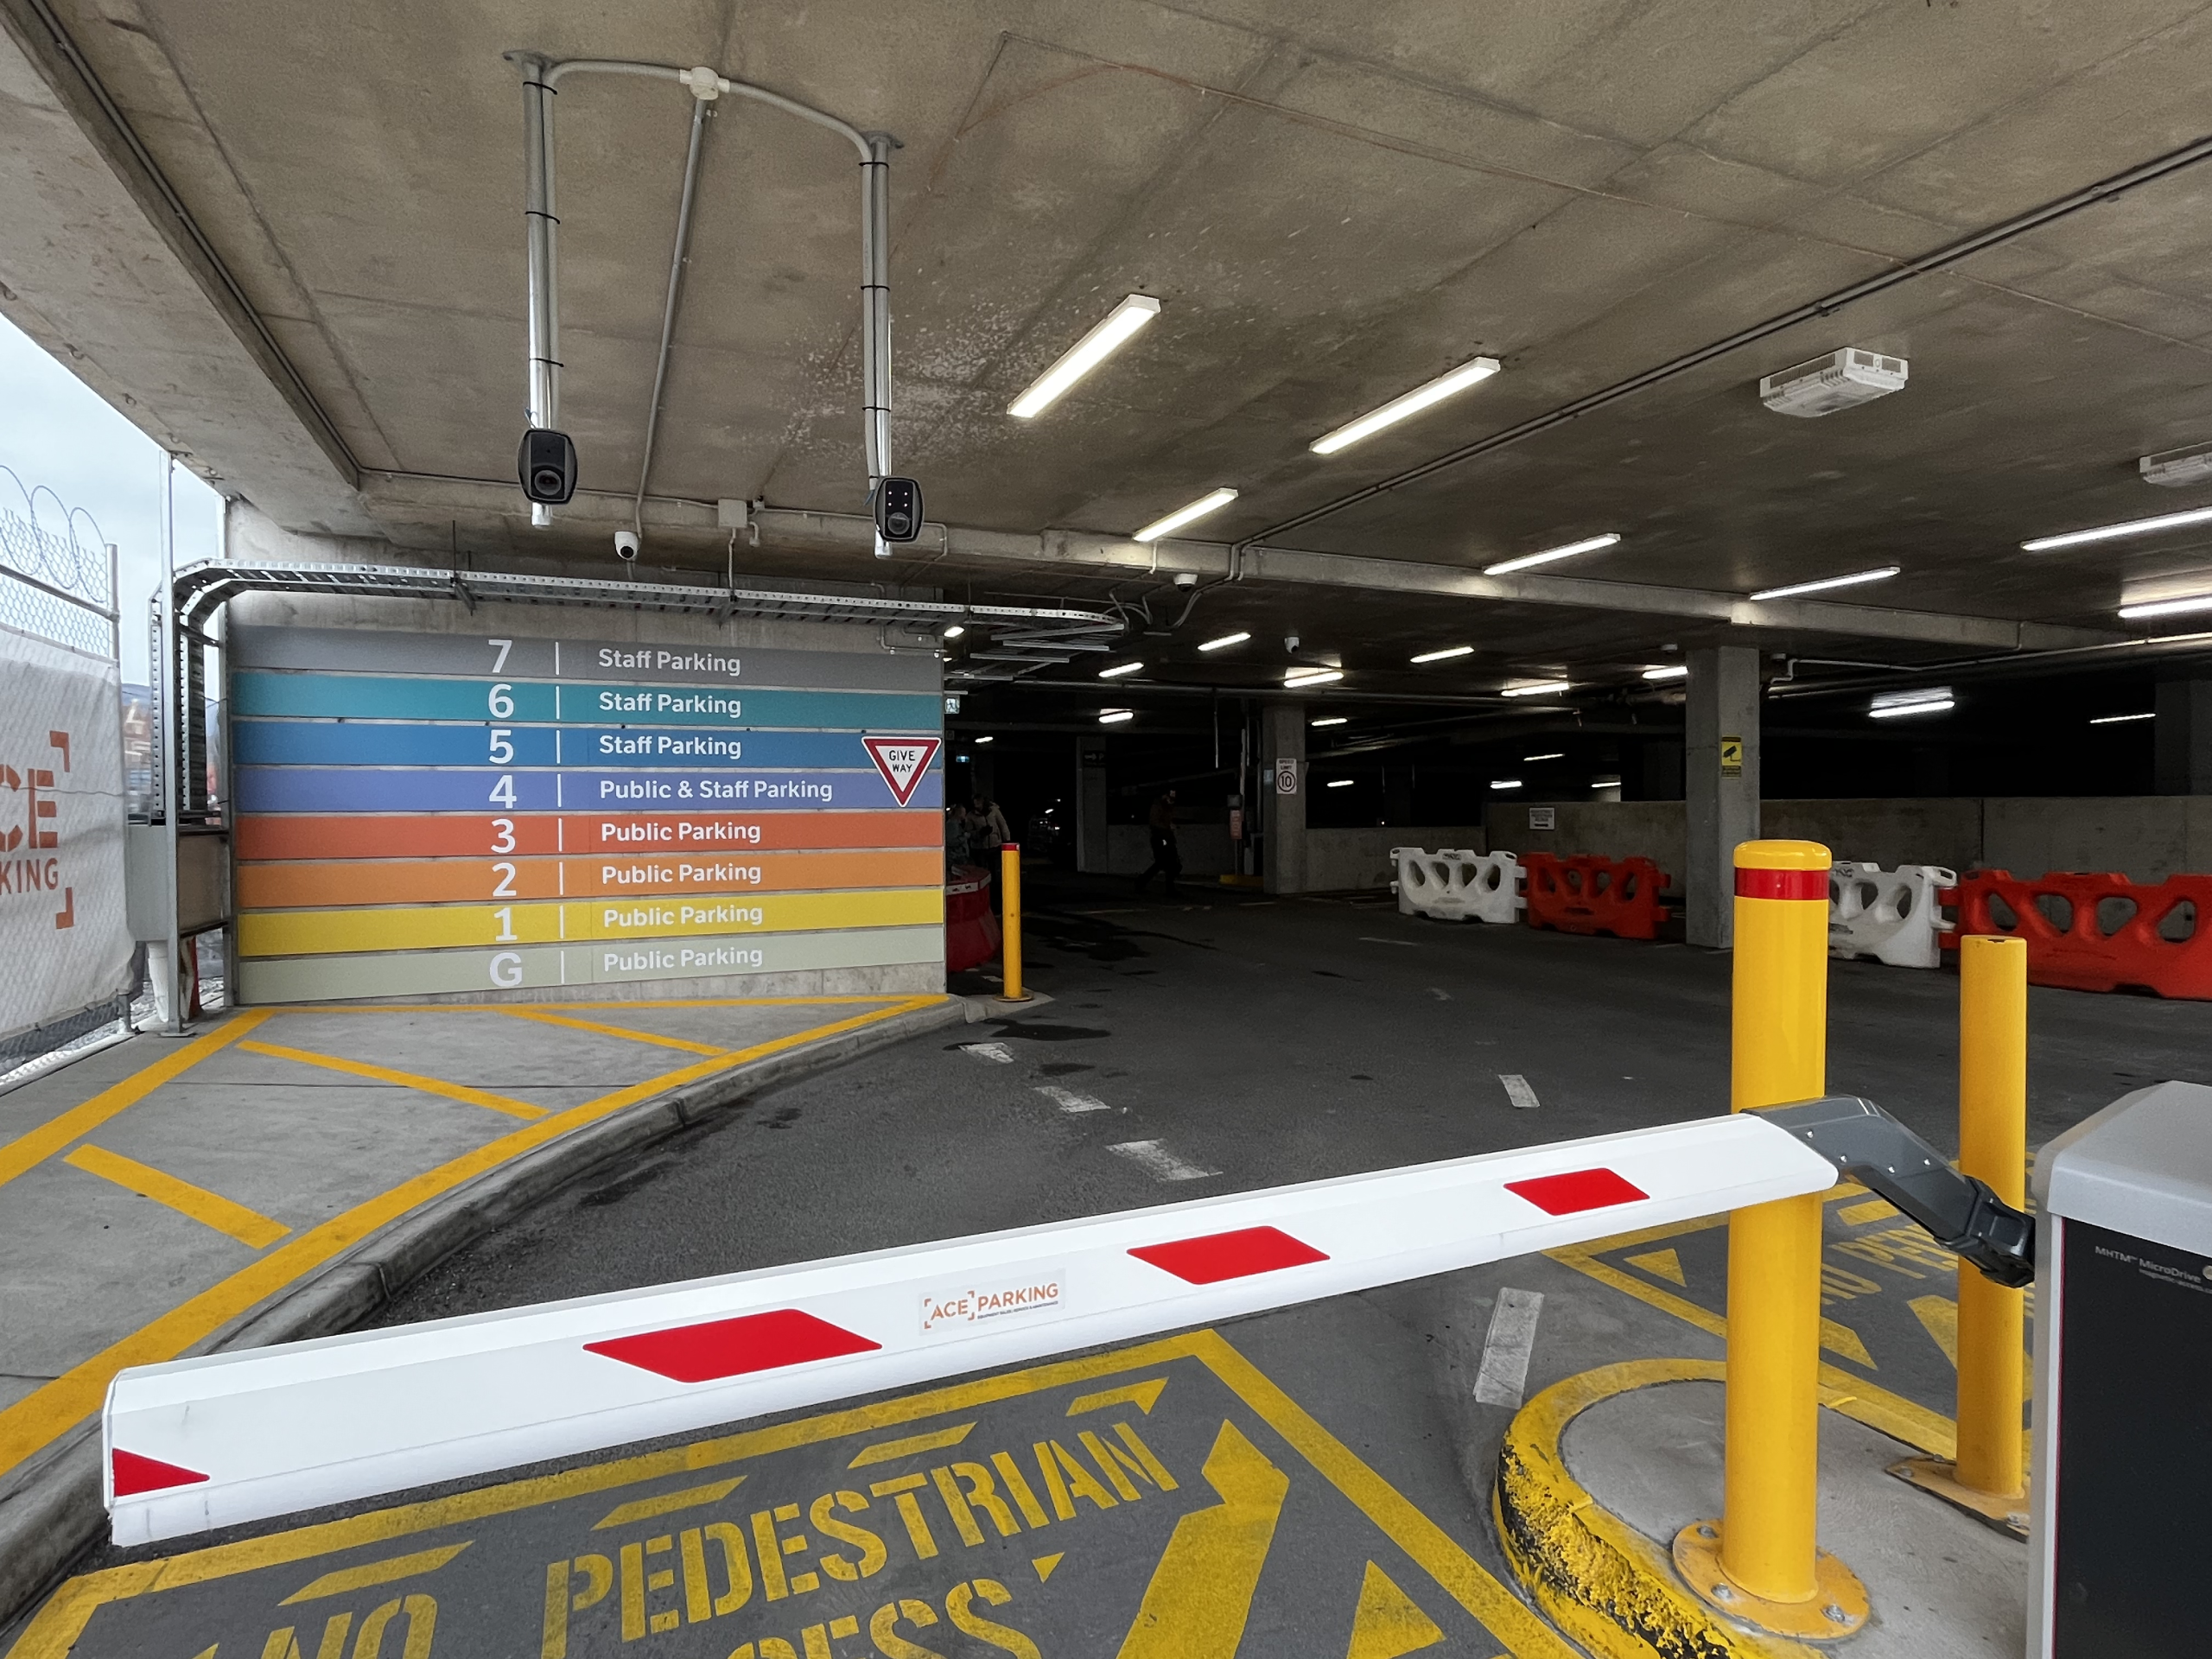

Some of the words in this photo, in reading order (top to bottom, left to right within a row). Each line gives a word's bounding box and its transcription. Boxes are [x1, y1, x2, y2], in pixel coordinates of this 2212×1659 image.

[488, 639, 512, 673] 7
[599, 648, 652, 669] Staff
[657, 651, 741, 677] Parking
[488, 683, 514, 718] 6
[599, 691, 652, 712] Staff
[658, 694, 741, 718] Parking
[489, 729, 514, 764] 5
[599, 735, 652, 754] Staff
[658, 736, 741, 760] Parking
[888, 750, 916, 761] GIVE
[892, 764, 912, 772] WAY
[1281, 775, 1292, 787] 10
[489, 774, 517, 809] 4
[600, 779, 671, 799] Public
[677, 780, 694, 798] &
[699, 780, 749, 798] Staff
[753, 780, 833, 802] Parking
[491, 818, 516, 854] 3
[601, 823, 672, 842] Public
[678, 822, 761, 843] Parking
[492, 862, 517, 897] 2
[602, 865, 673, 885] Public
[679, 862, 761, 884] Parking
[494, 907, 518, 942] 1
[604, 906, 675, 927] Public
[680, 905, 763, 925] Parking
[490, 952, 523, 988] G
[604, 950, 675, 971] Public
[680, 947, 763, 967] Parking
[2139, 1258, 2201, 1283] MicroDrive
[930, 1299, 968, 1320] ACE
[977, 1283, 1058, 1312] PARKING
[541, 1422, 1179, 1659] PEDESTRIAN
